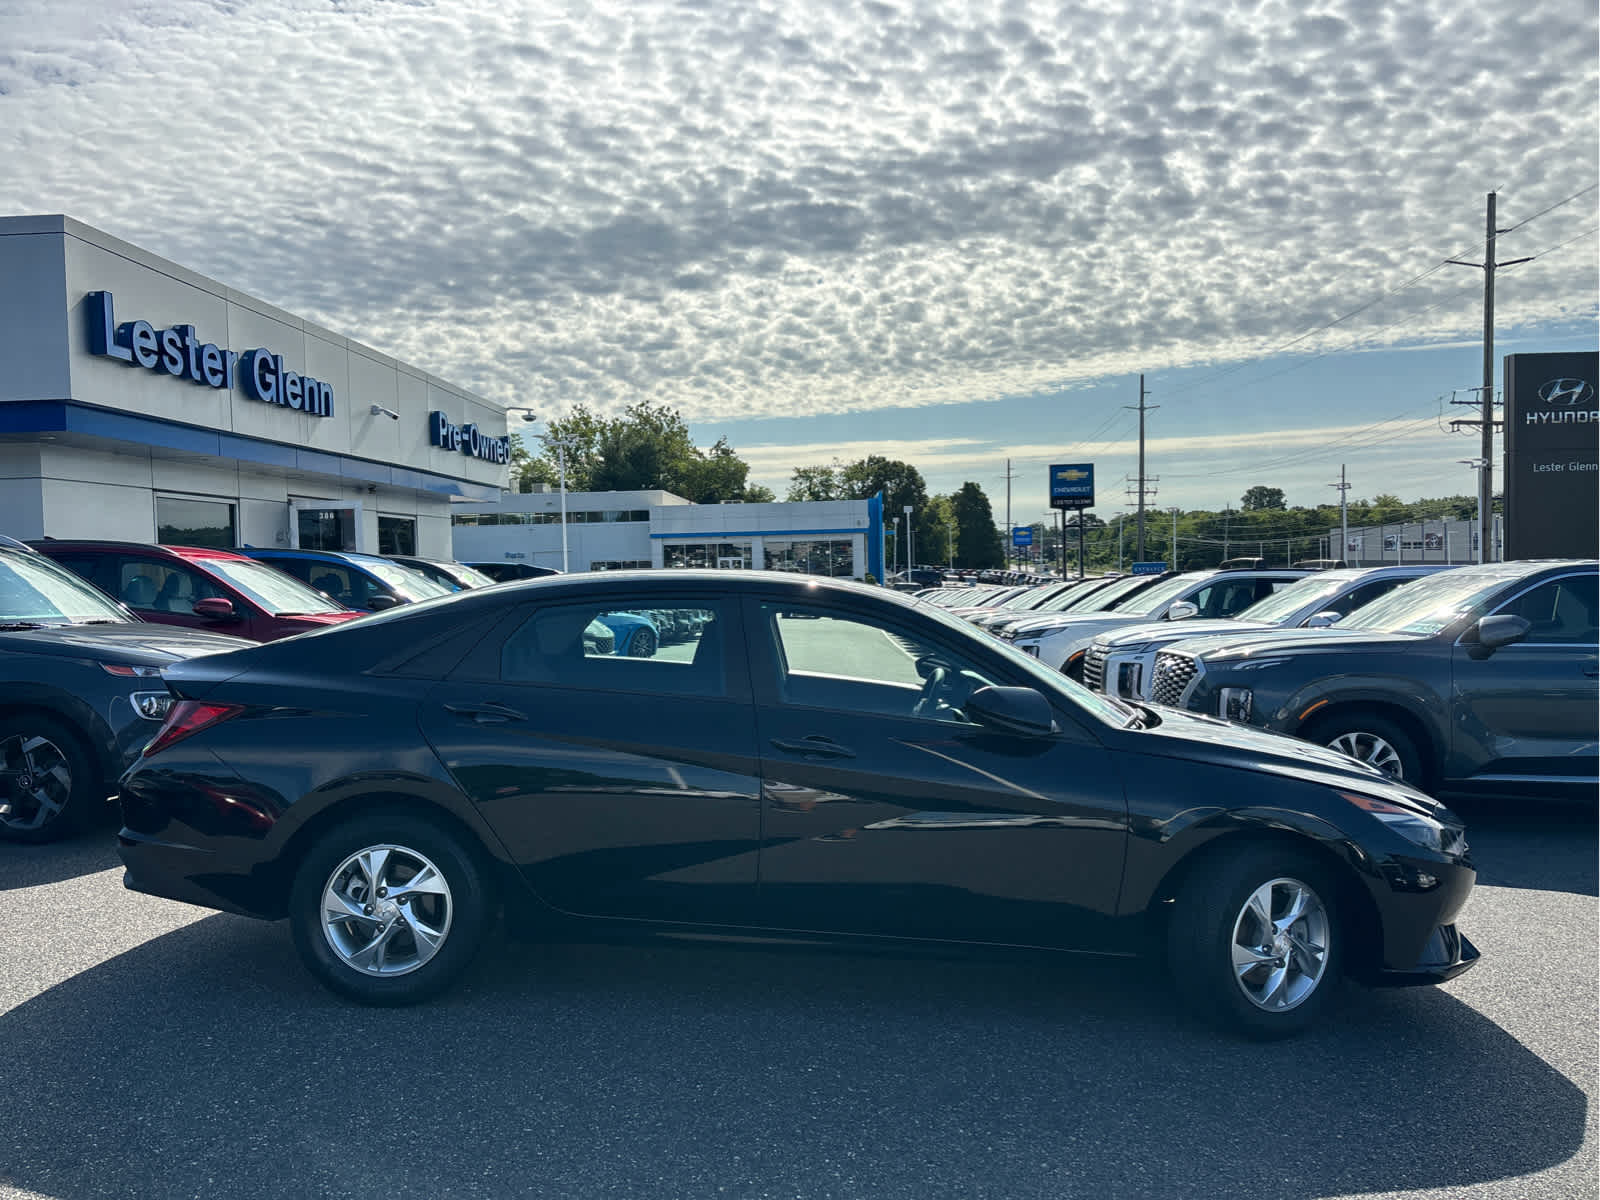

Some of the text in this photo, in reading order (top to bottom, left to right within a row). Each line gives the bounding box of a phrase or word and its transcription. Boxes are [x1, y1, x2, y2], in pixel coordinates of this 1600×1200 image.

[88, 291, 334, 417] Lester Glenn
[430, 410, 512, 464] Pre-Owned
[1533, 462, 1598, 472] Lester Glenn
